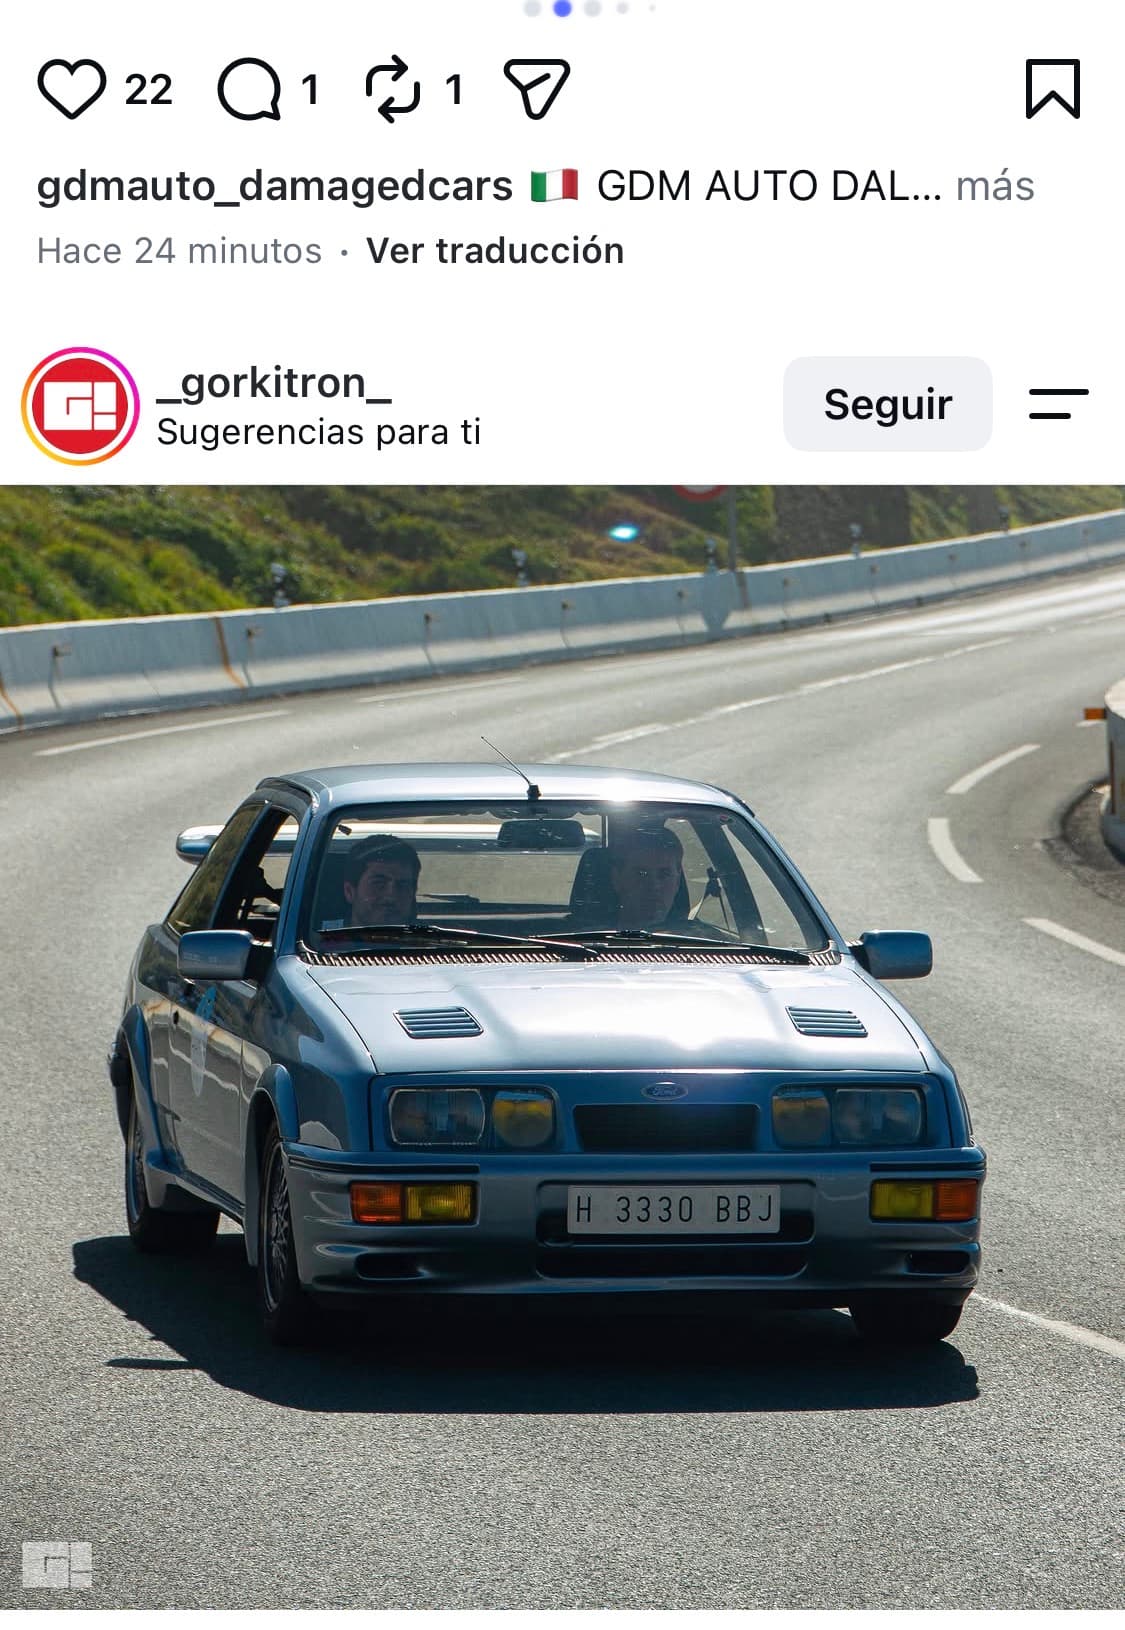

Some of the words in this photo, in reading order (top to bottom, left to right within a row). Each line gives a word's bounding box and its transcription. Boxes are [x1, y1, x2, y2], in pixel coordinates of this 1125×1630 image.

[125, 72, 173, 105] 22
[301, 73, 317, 105] 1
[445, 73, 461, 105] 1
[37, 168, 513, 209] gdmauto_damagedcars
[597, 169, 690, 202] GDM
[704, 169, 818, 202] AUTO
[957, 167, 1035, 201] más
[38, 236, 122, 264] Hace
[135, 236, 176, 264] 24
[189, 235, 322, 264] minutos
[365, 236, 425, 265] Ver
[435, 234, 624, 265] traducción
[155, 364, 393, 406] _gorkitron_
[824, 386, 954, 428] Seguir
[157, 416, 364, 452] Sugerencias
[377, 423, 448, 452] para
[460, 416, 481, 445] ti
[576, 1195, 592, 1223] H
[616, 1195, 693, 1223] 3330
[716, 1194, 772, 1223] BBJ
